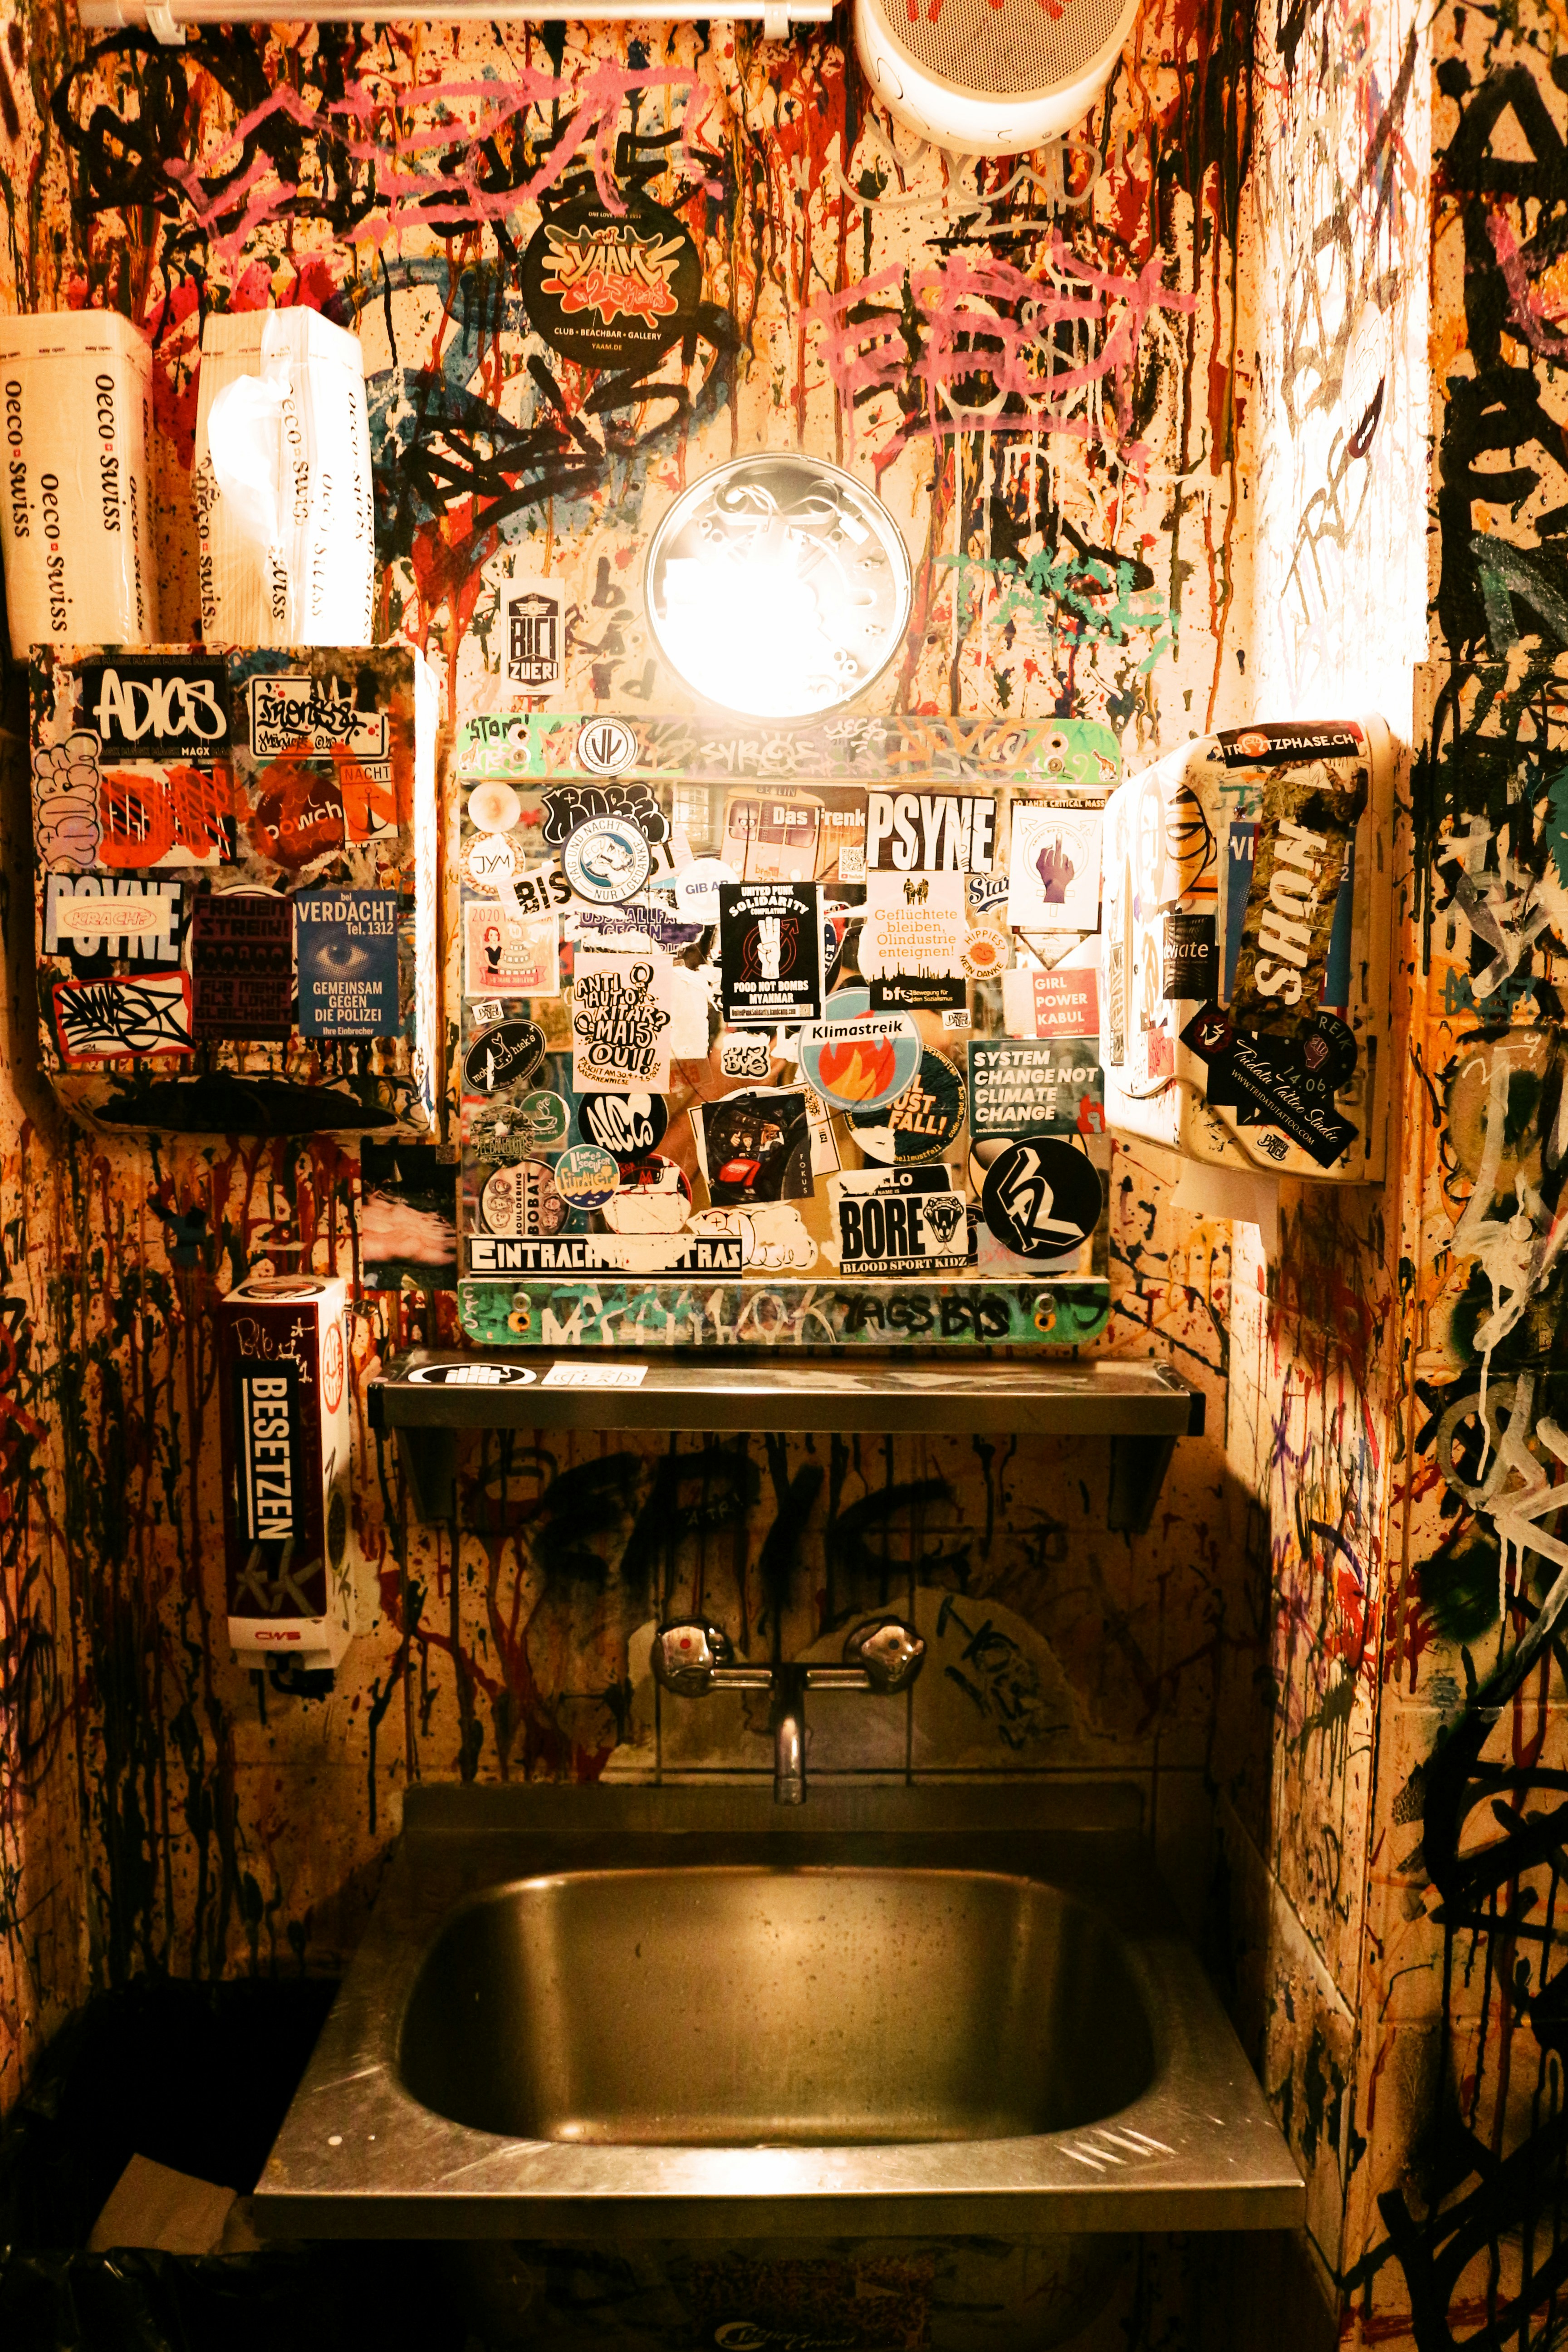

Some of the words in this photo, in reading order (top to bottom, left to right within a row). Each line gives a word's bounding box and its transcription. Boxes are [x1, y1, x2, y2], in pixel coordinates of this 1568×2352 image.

[560, 243, 662, 289] YAAM
[554, 327, 574, 336] CLUB
[580, 328, 622, 339] BEACHBAR
[628, 332, 662, 341] GALLERY
[592, 343, 622, 351] YAAM.DE
[5, 380, 24, 446] oeco
[95, 374, 115, 440] oeco
[9, 460, 35, 538] swiss
[100, 454, 127, 533] swiss
[41, 473, 61, 540] oeco
[129, 476, 140, 544] oeco
[46, 554, 74, 632] swiss
[133, 554, 149, 632] swiss
[199, 554, 222, 631] swiss
[510, 617, 556, 661] BICI
[510, 662, 558, 680] ZUERI
[181, 747, 210, 756] MAGX
[345, 765, 390, 781] NACHT
[757, 786, 795, 797] BELIN
[1049, 799, 1083, 808] CRITICAL
[773, 806, 808, 825] Das
[583, 820, 623, 836] NACHT
[868, 793, 995, 873] PSYNE
[568, 834, 584, 857] UND
[567, 861, 582, 884] TAG
[594, 889, 618, 900] NUR
[627, 838, 647, 891] GEDANKE
[340, 892, 353, 902] bei
[685, 882, 708, 895] GIB
[740, 885, 771, 897] UNITED
[772, 885, 794, 897] PUNK
[298, 901, 396, 922] VERDACHT
[472, 909, 500, 922] 2020
[728, 896, 810, 917] SOLIDARITY
[750, 907, 787, 916] COMPILATION
[874, 909, 958, 921] Geflüchtete
[199, 918, 289, 937] STREIK!
[346, 921, 366, 936] Tel.
[368, 921, 394, 935] 1312
[887, 921, 946, 934] bleiben,
[877, 933, 956, 945] Ölindustrie
[964, 930, 1006, 951] HIPPIES?
[879, 946, 955, 960] enteignen!
[1163, 939, 1209, 960] deviate
[959, 955, 975, 975] NEIN
[976, 961, 1004, 978] DANKE
[313, 981, 383, 995] GEMEINSAM
[576, 971, 621, 998] ANTI
[733, 981, 757, 993] FOOD
[758, 981, 777, 992] NOT
[778, 980, 809, 991] BOMBS
[1034, 977, 1067, 990] GIRL
[328, 995, 367, 1009] GEGEN
[588, 988, 637, 1007] AUTO
[749, 992, 794, 1004] MYANMAR
[1036, 993, 1088, 1007] POWER
[314, 1009, 334, 1022] DIE
[337, 1008, 382, 1022] POLIZEI
[1037, 1011, 1085, 1025] KABUL
[323, 1026, 337, 1035] Ihre
[337, 1026, 374, 1036] Einbrecher
[595, 1020, 652, 1049] MAIS
[812, 1020, 903, 1039] Klimastreik
[588, 1043, 656, 1075] OUI!
[974, 1050, 1051, 1067] SYSTEM
[604, 1068, 616, 1078] AM
[974, 1068, 1055, 1085] CHANGE
[1057, 1067, 1099, 1083] NOT
[975, 1087, 1058, 1103] CLIMATE
[1233, 1039, 1273, 1085] Tridatu
[1273, 1073, 1305, 1113] Tattoo
[1304, 1108, 1343, 1143] Studio
[886, 1092, 937, 1114] UST
[1231, 1069, 1315, 1145] WWW.TRIDATUTATTOO.COM
[888, 1109, 948, 1136] FALL!
[975, 1105, 1056, 1122] CHANGE
[799, 1153, 809, 1194] FOKUS
[527, 1172, 539, 1235] BOBAT
[838, 1197, 926, 1259] BORE
[842, 1261, 888, 1274] BLOOD
[890, 1259, 933, 1270] SPORT
[935, 1256, 968, 1268] KIDZ
[251, 1377, 294, 1540] BESETZEN
